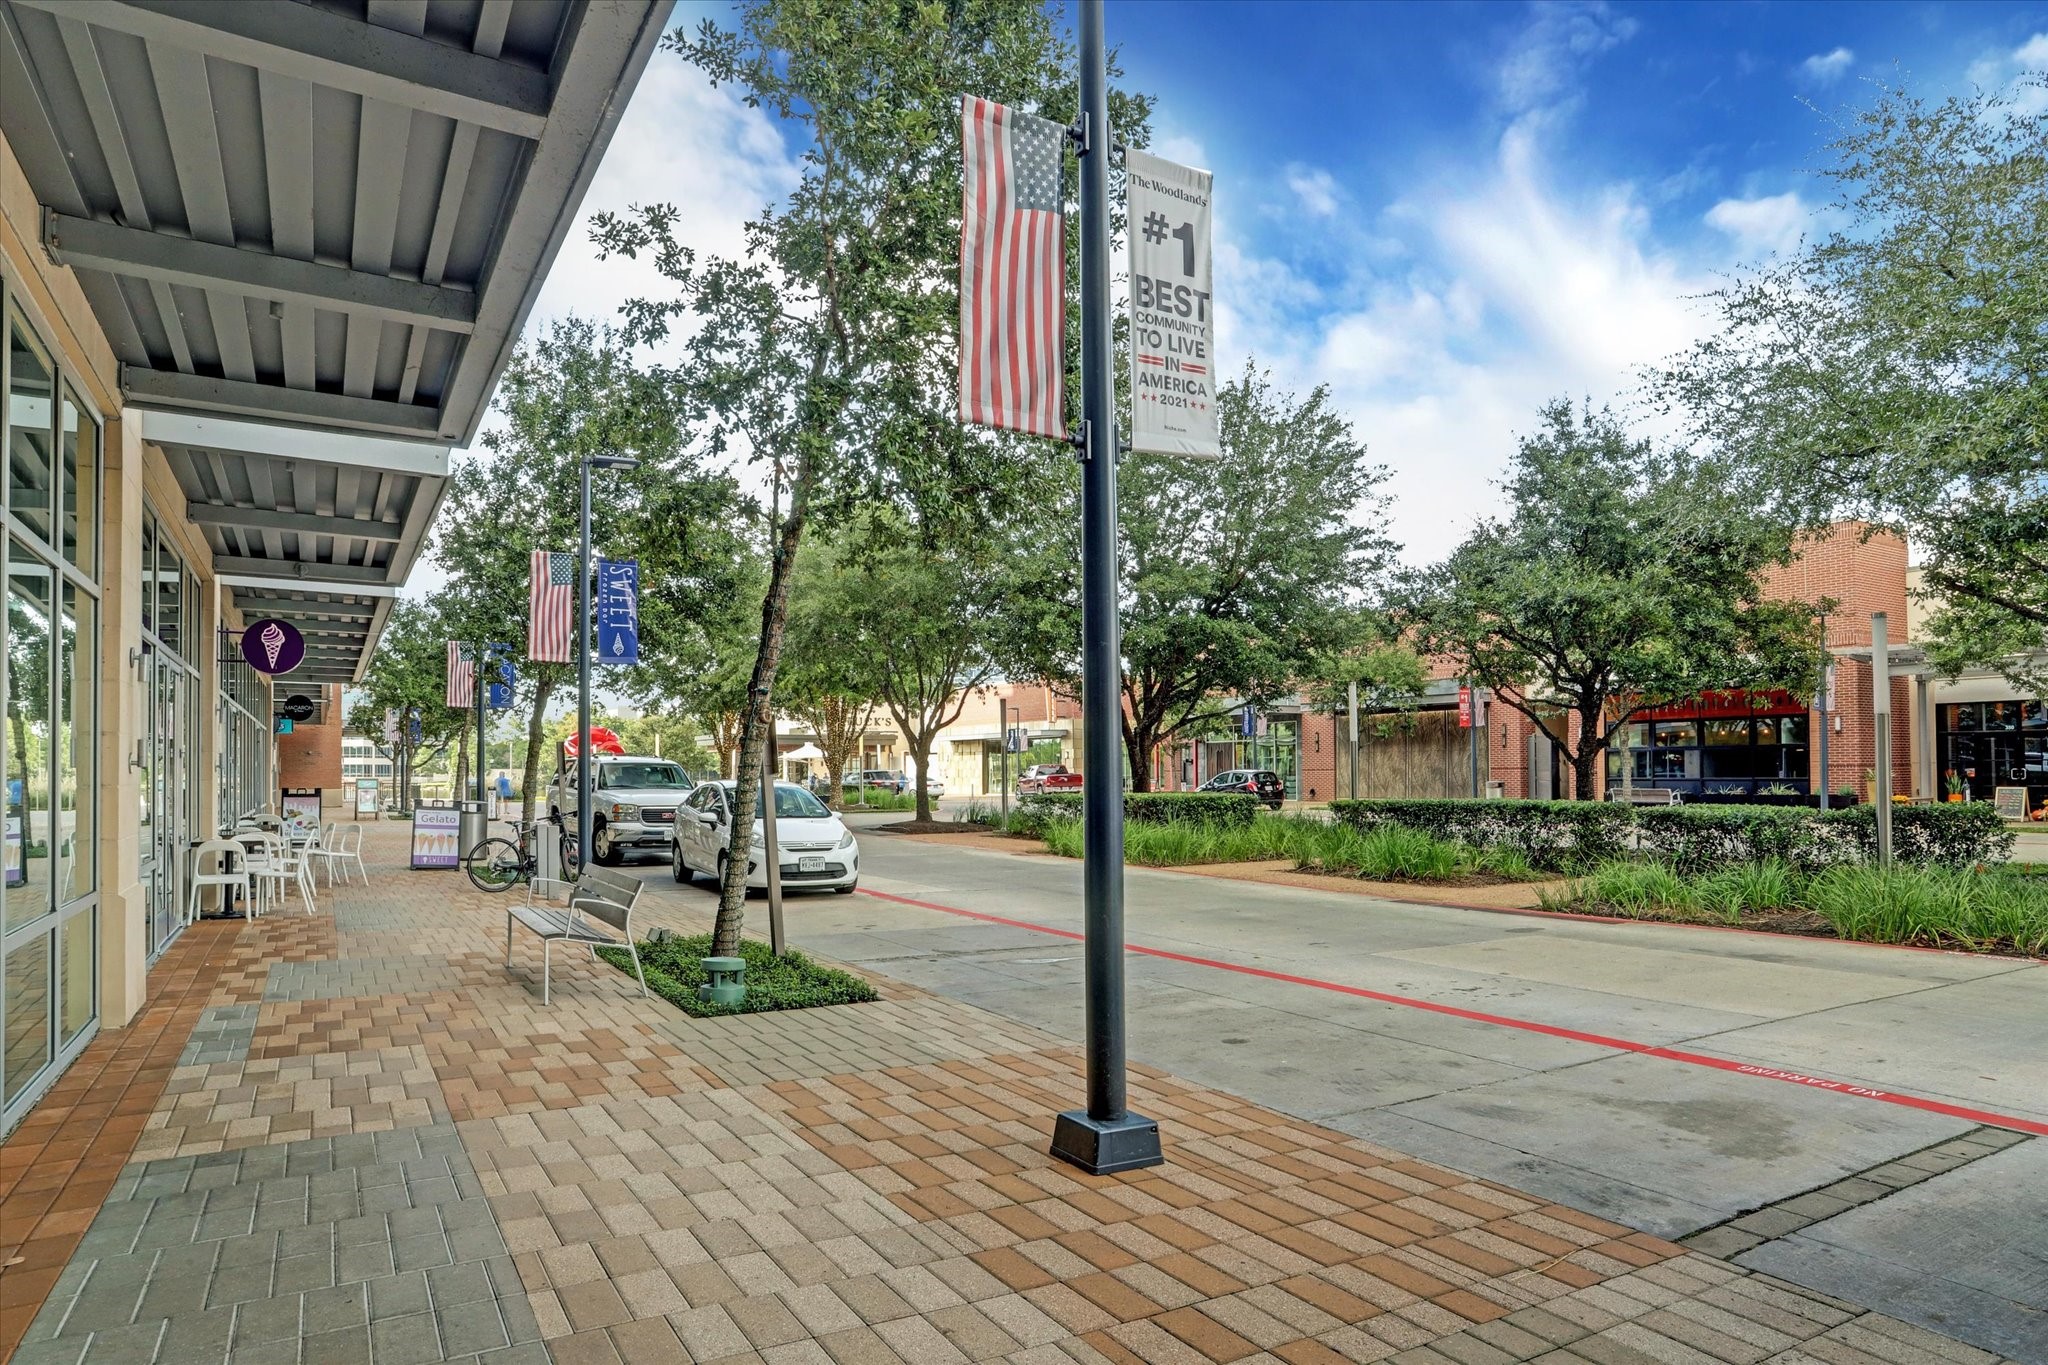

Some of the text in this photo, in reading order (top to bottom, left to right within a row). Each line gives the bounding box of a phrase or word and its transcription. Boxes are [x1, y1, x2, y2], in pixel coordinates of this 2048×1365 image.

[1129, 173, 1207, 207] The Woodlands
[1142, 211, 1195, 278] #1
[1136, 274, 1210, 323] BEST
[1136, 311, 1206, 338] COMMUNITY
[1136, 327, 1206, 359] TO LIVE
[1165, 356, 1180, 373] IN
[1138, 372, 1208, 398] AMERICA
[1160, 394, 1188, 408] 2021
[609, 566, 633, 631] SWEET
[421, 814, 456, 824] Gelato
[1737, 1065, 1886, 1097] NO PARKING
